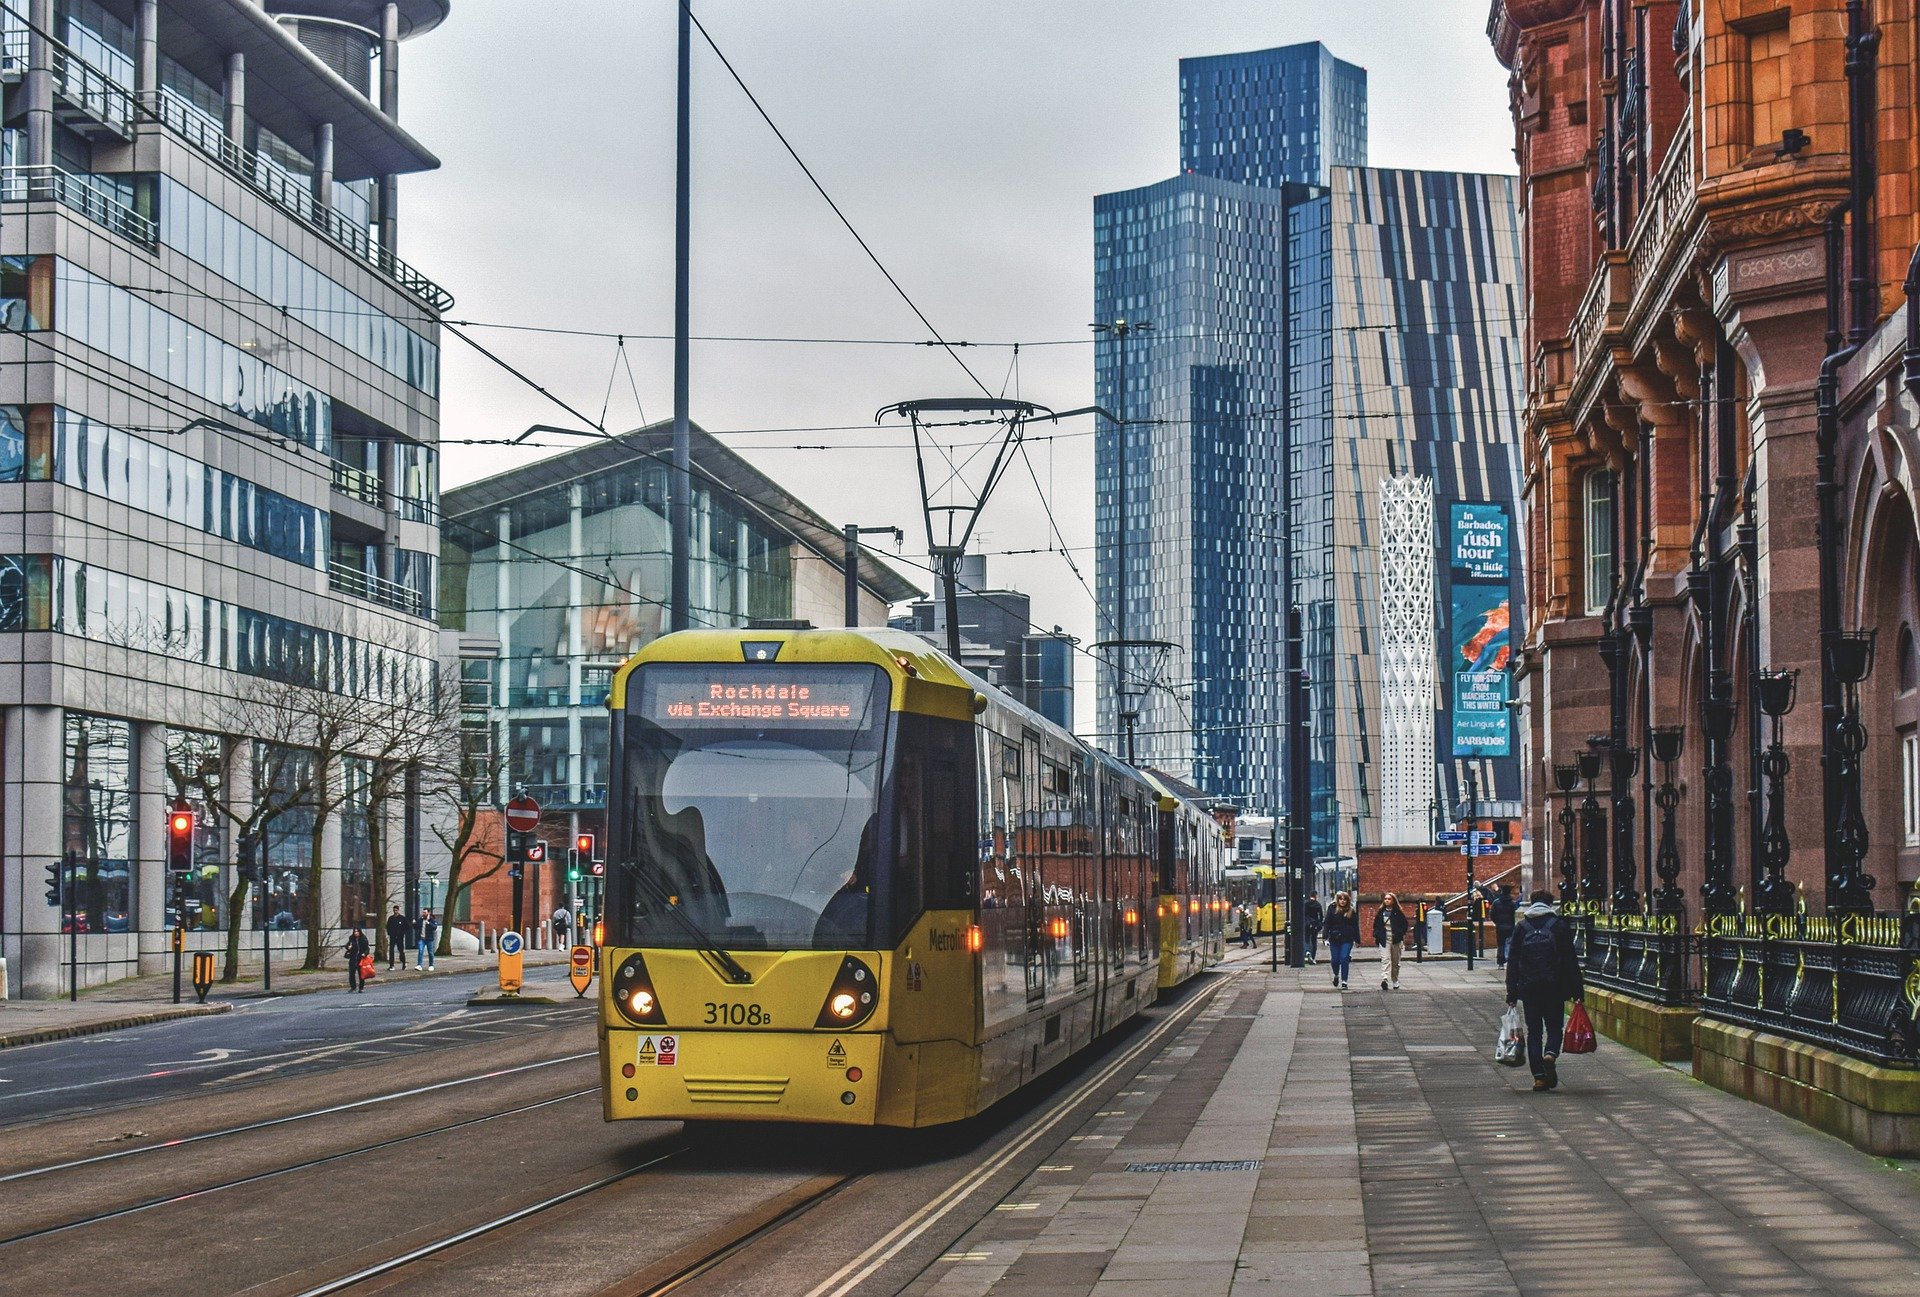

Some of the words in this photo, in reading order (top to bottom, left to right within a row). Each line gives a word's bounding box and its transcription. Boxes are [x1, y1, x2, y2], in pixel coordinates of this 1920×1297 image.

[1458, 520, 1504, 530] Barbados,
[1463, 531, 1502, 546] rush
[1457, 544, 1494, 560] hour
[1475, 563, 1481, 571] a
[1483, 561, 1504, 572] little
[1460, 674, 1470, 682] FLY
[1472, 674, 1502, 683] NON-STOP
[710, 684, 810, 700] Rochdale
[1472, 684, 1490, 692] FROM
[1462, 692, 1500, 700] MANCHESTER
[667, 702, 693, 717] via
[698, 702, 782, 718] Exchange
[788, 702, 850, 718] Square
[1463, 701, 1476, 709] THIS
[1478, 702, 1500, 710] WINTER
[1471, 720, 1494, 730] Lingus
[1457, 736, 1506, 746] BARBADOS
